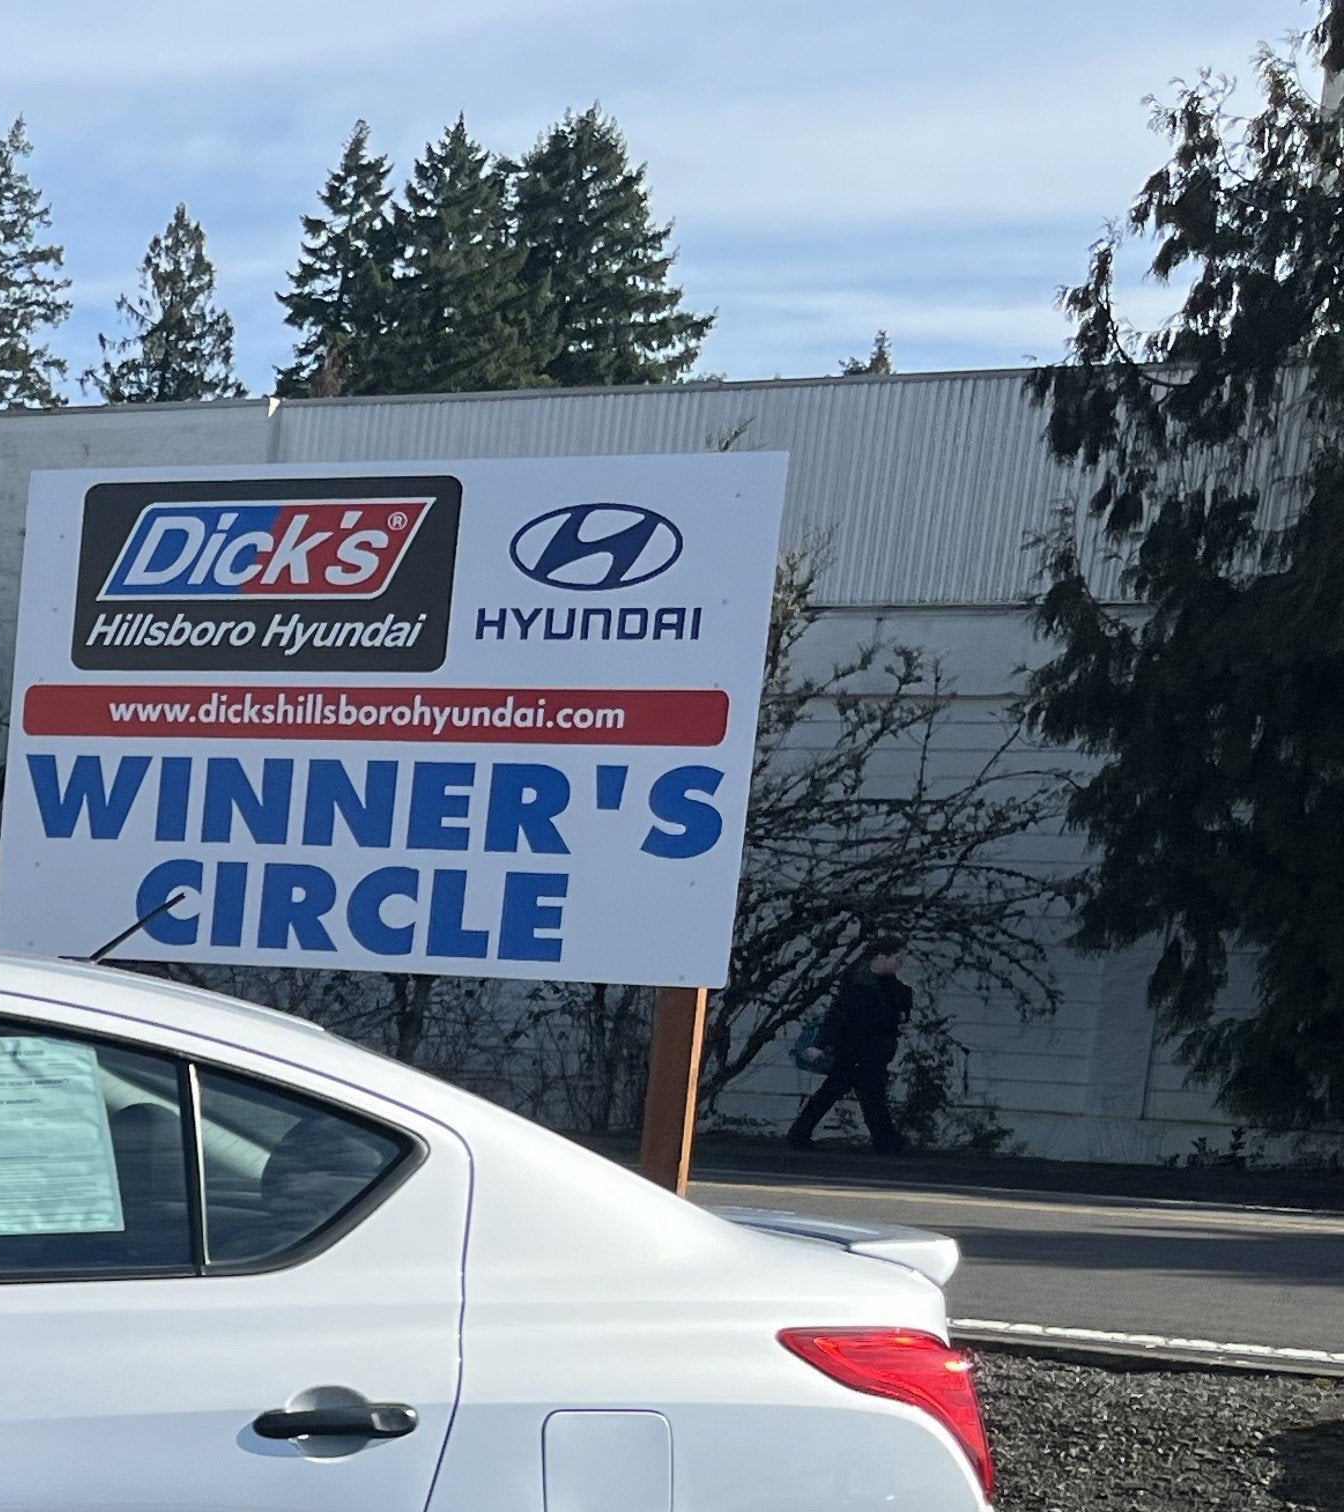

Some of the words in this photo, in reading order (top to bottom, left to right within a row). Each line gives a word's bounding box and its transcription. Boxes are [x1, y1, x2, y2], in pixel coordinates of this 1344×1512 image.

[123, 511, 388, 586] Dick's
[85, 613, 255, 648] Hillsboro
[262, 613, 427, 656] Hyundai
[475, 608, 702, 641] HYUNDAI
[110, 693, 625, 731] www.dickshillsborohyundai.com
[27, 754, 724, 859] WINNER'S
[135, 857, 570, 963] CIRCLE
